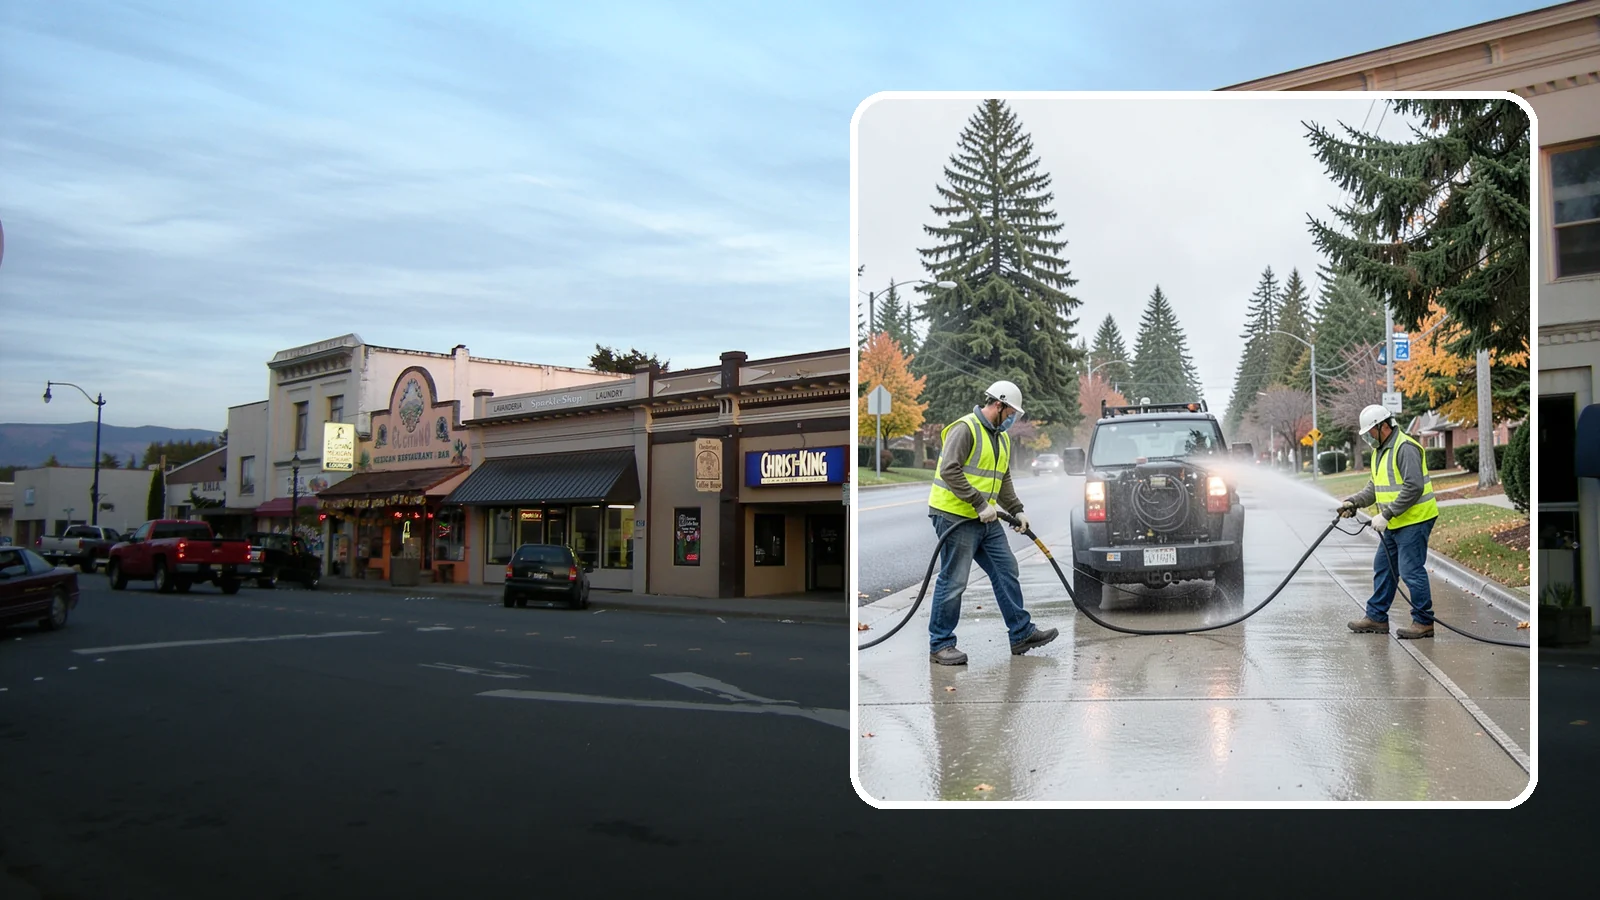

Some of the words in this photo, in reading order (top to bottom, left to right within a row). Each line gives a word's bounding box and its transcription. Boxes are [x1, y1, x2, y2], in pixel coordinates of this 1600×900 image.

[531, 397, 561, 409] Sparkle
[562, 394, 582, 405] Shop
[596, 389, 623, 400] LAUNDRY
[494, 402, 523, 413] LAVANDERIA
[374, 455, 396, 464] MEXICAN
[398, 452, 433, 462] RESTAURANT
[438, 450, 450, 459] BAR
[761, 452, 797, 478] CHRIST
[799, 450, 827, 476] KING
